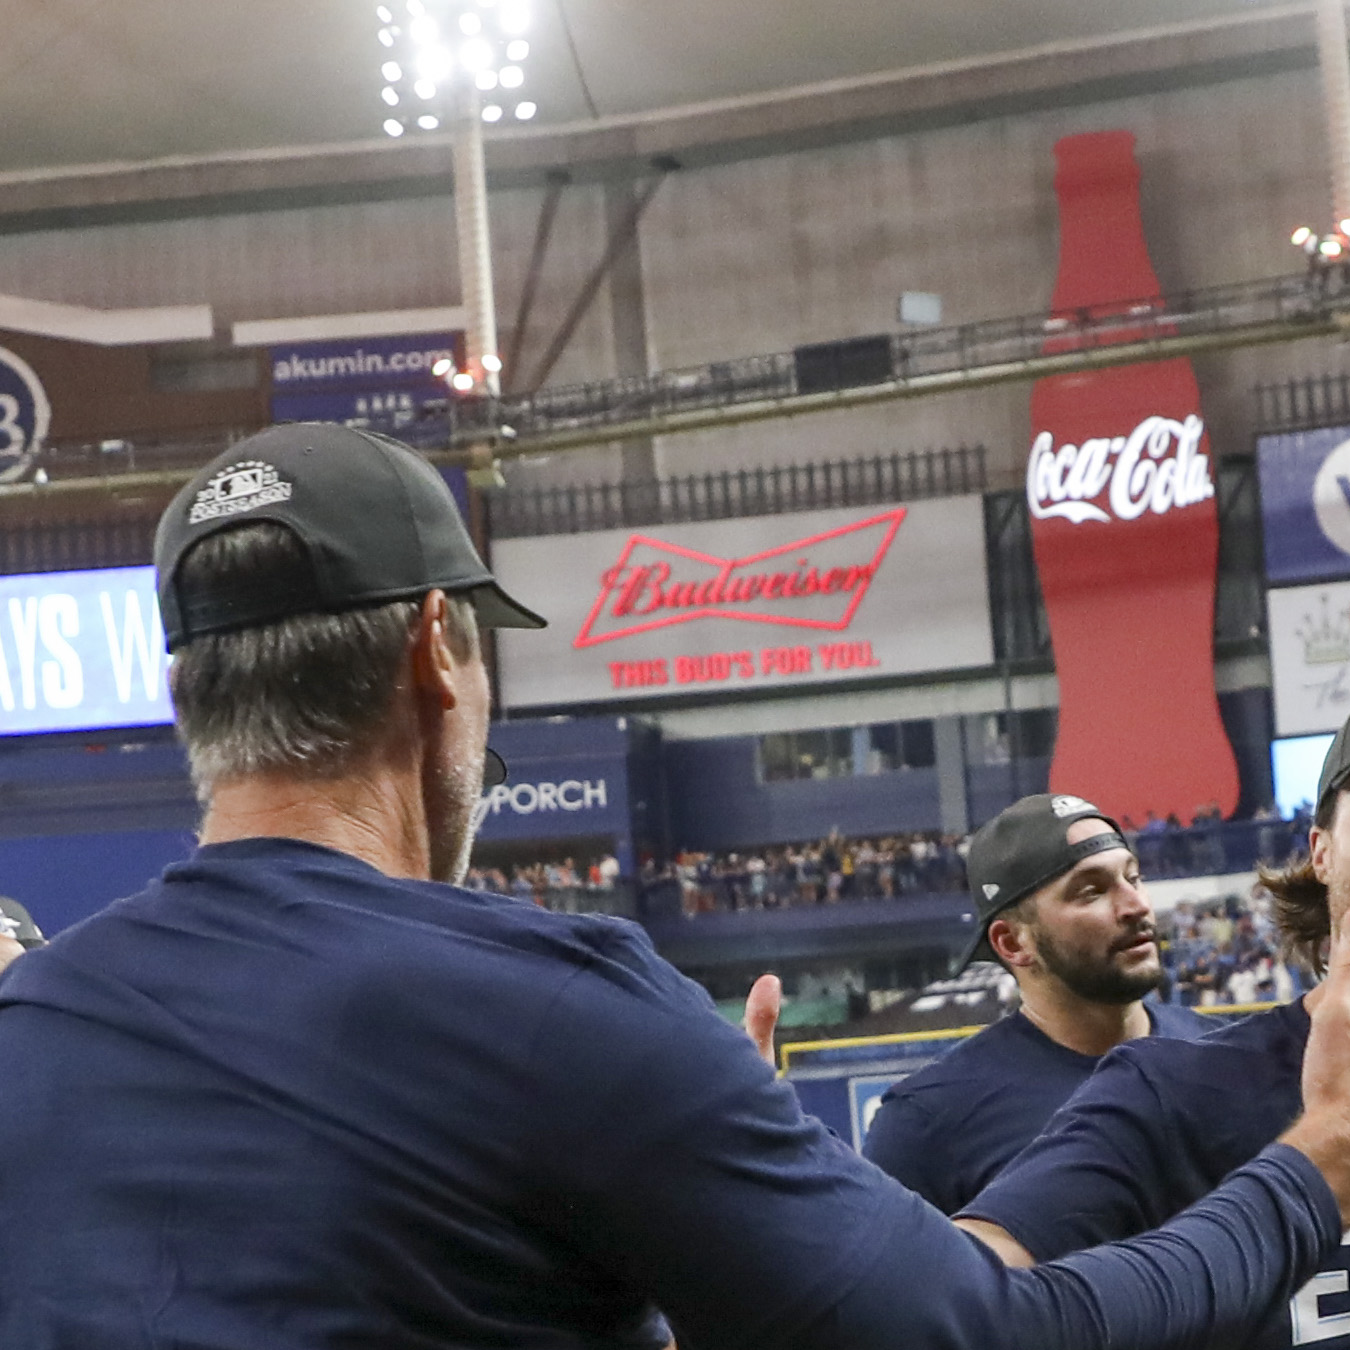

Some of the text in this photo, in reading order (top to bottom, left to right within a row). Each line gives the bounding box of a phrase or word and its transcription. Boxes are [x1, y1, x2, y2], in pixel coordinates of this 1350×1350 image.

[1027, 413, 1215, 524] Coca-Cola
[600, 556, 876, 617] Budweiser
[608, 640, 880, 689] THIS BUD'S FOR YOU.
[488, 778, 609, 816] PORCH
